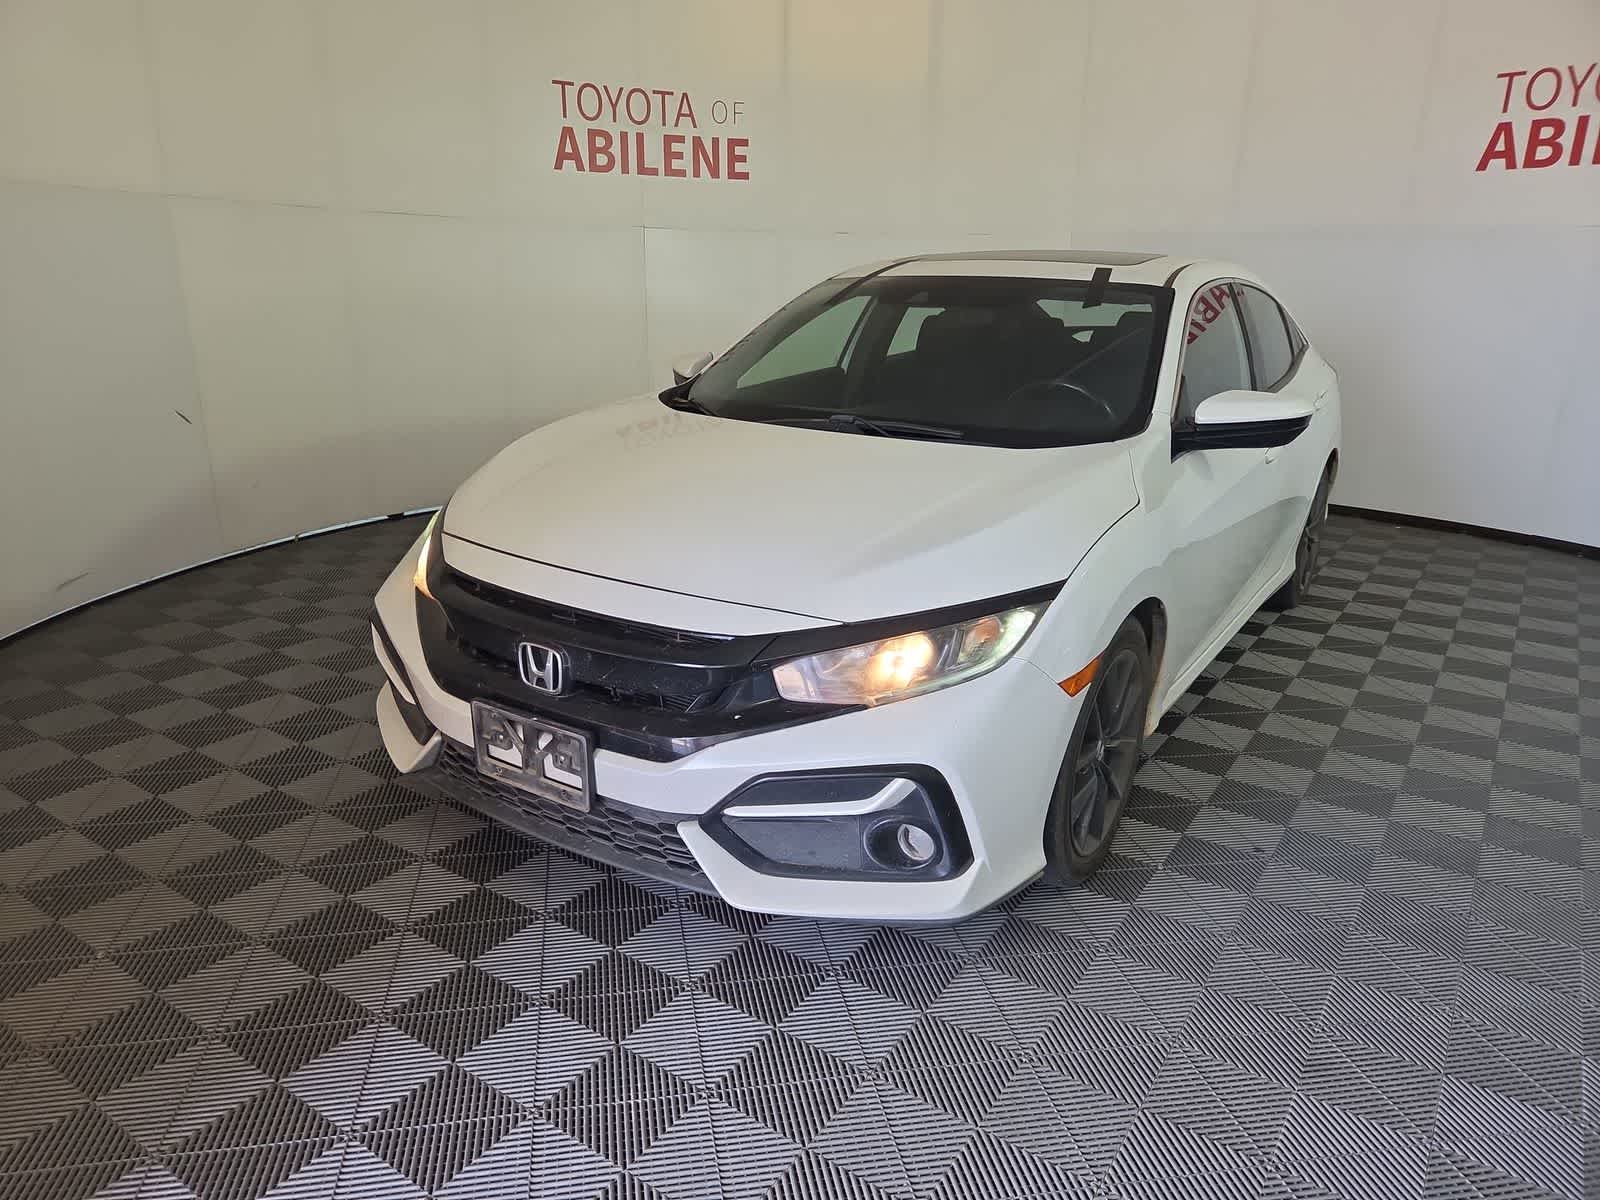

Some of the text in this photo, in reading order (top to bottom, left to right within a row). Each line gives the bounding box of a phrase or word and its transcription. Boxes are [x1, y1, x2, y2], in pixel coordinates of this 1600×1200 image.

[552, 79, 745, 128] TOYOTA OF
[1496, 62, 1600, 114] TOY
[553, 126, 750, 180] ABILENE
